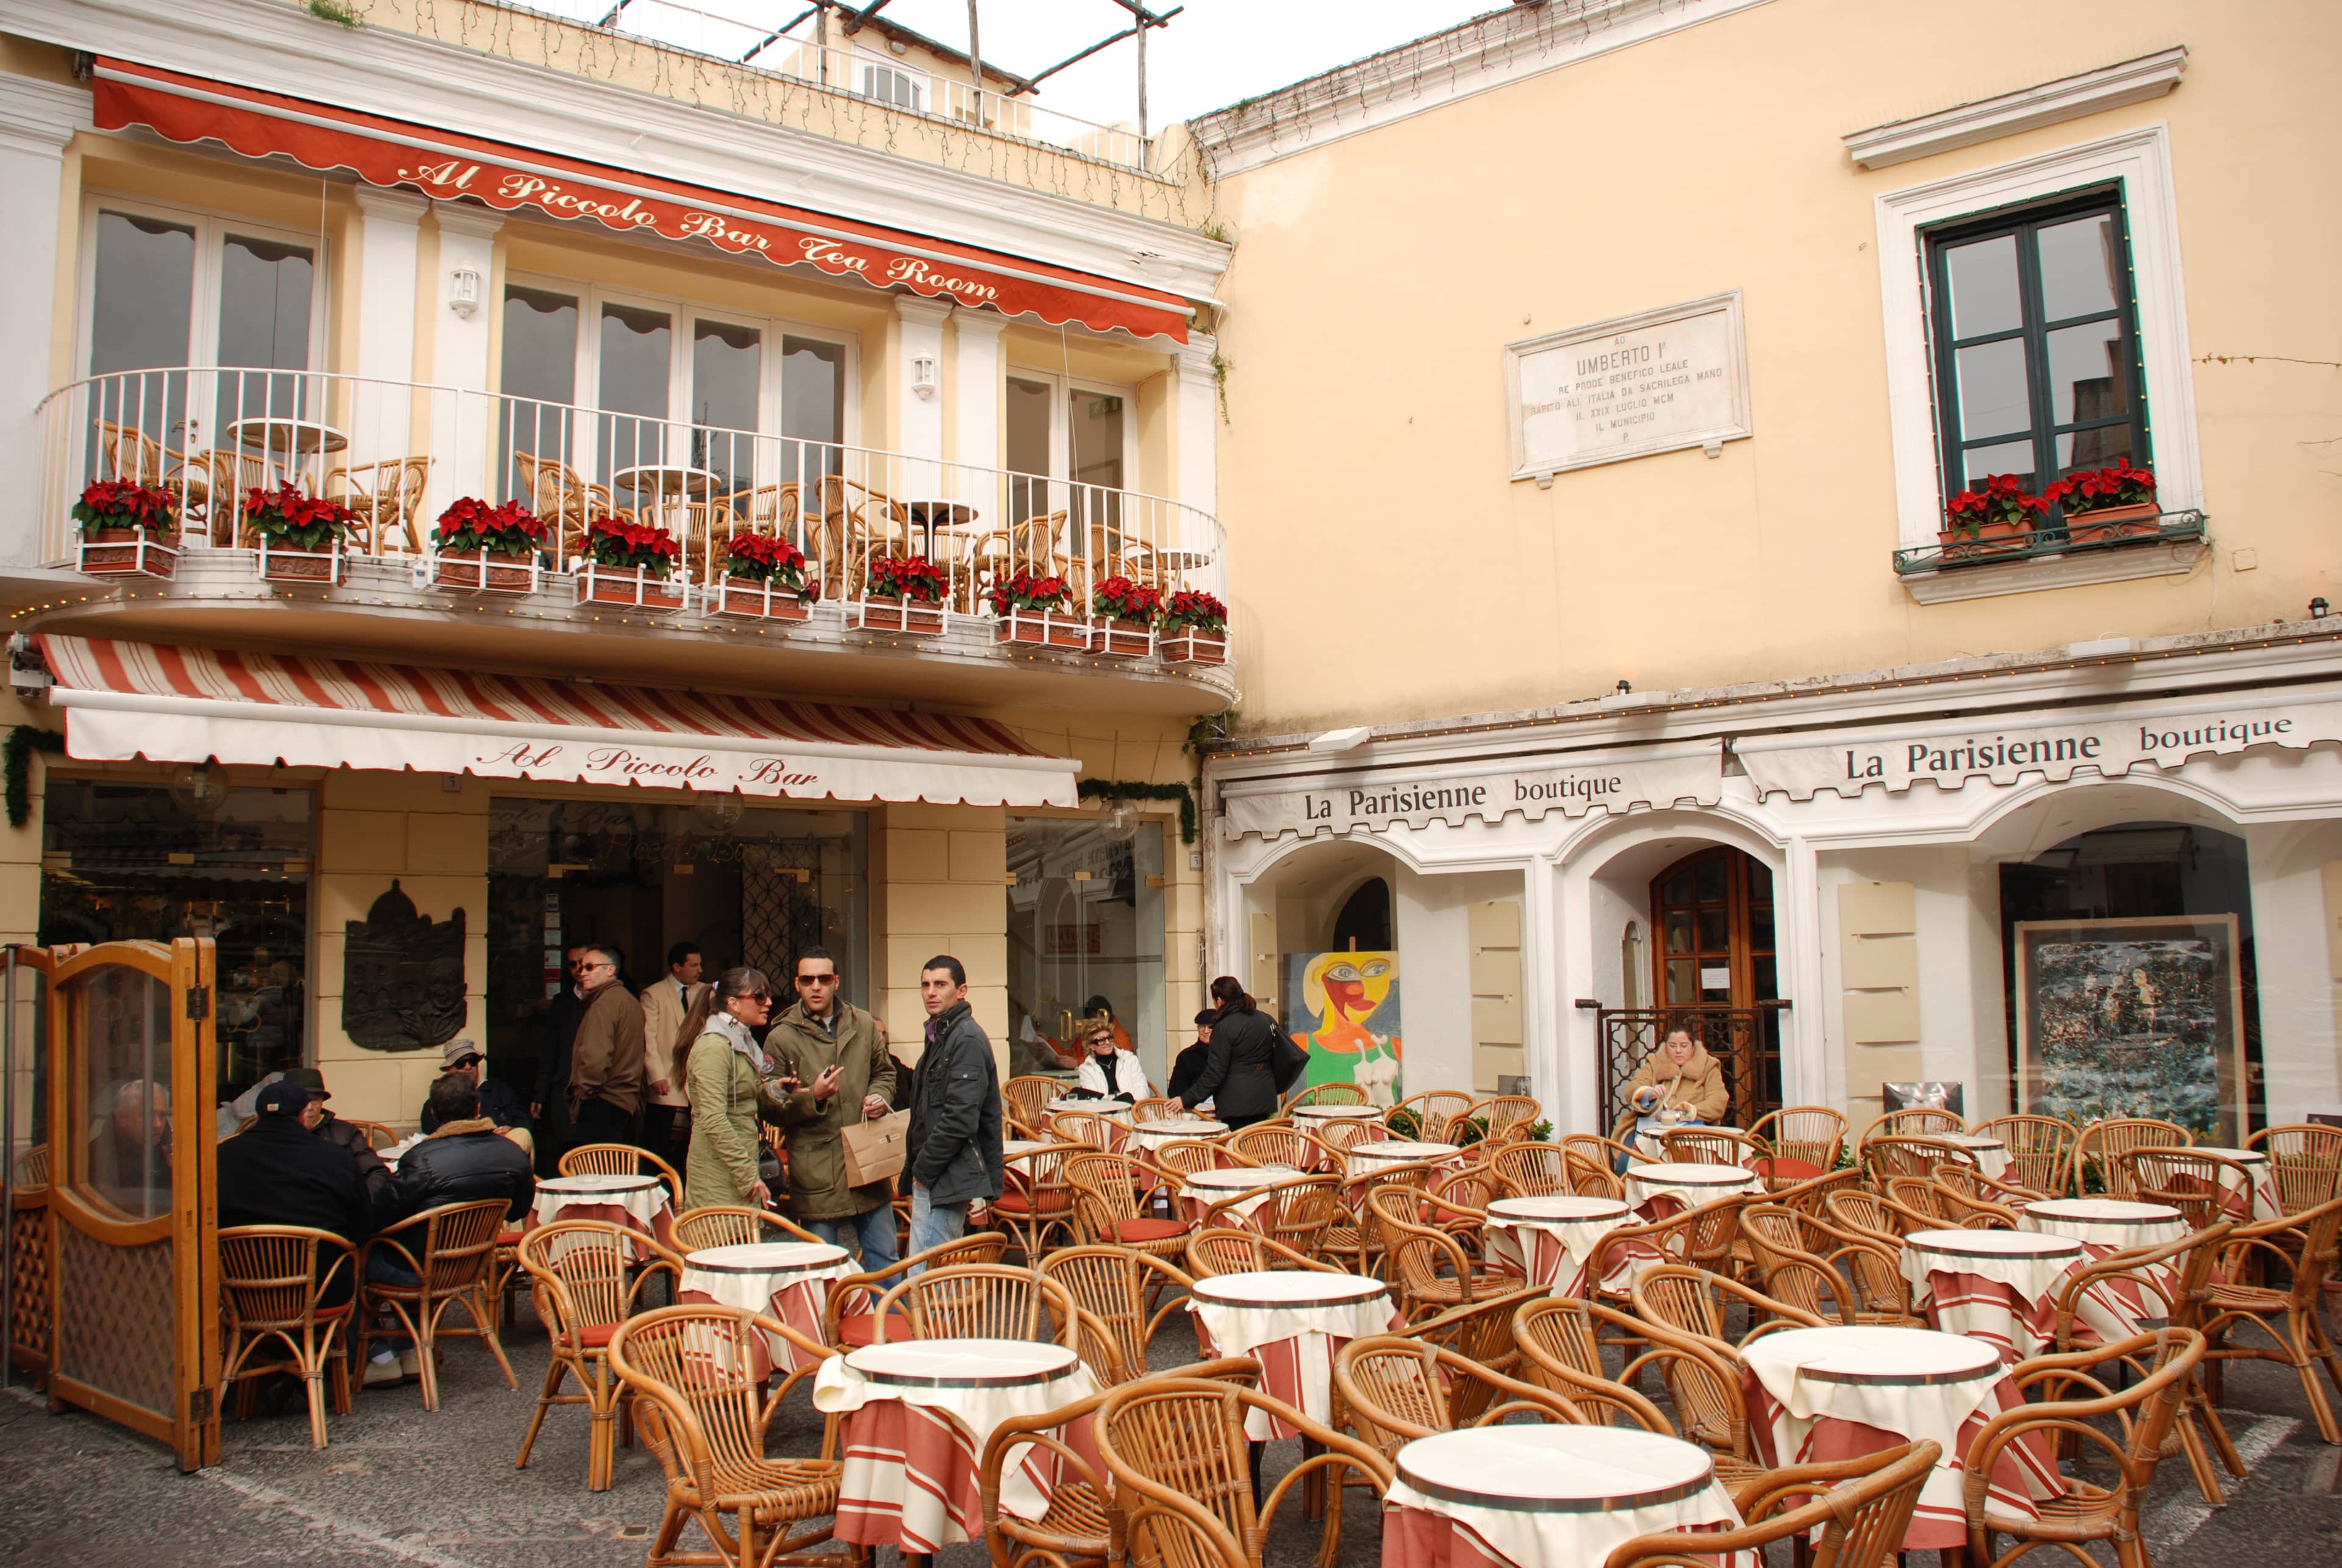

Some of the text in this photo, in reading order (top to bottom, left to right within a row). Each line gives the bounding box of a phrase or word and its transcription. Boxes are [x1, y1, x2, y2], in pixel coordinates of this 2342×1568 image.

[398, 161, 998, 299] Al Piccolo Bar Tea Room
[1558, 385, 1569, 395] RE
[1610, 367, 1653, 384] BENEFICO
[1660, 359, 1688, 373] LEALE
[1577, 346, 1649, 376] UMBERTO
[1588, 390, 1615, 404] ITALIA
[1621, 387, 1633, 396] DA
[1639, 375, 1690, 392] SACRILEGA
[1697, 368, 1722, 381] MANO
[1591, 406, 1610, 418] XXIX
[1616, 398, 1647, 413] LUGLIO
[1653, 393, 1674, 404] MCM
[1595, 412, 1655, 432] IL MUNICIPIO
[476, 742, 818, 786] Al Piccolo Bar
[1846, 719, 2293, 780] La Parisienne boutique
[1305, 775, 1622, 820] La Parisienne boutique
